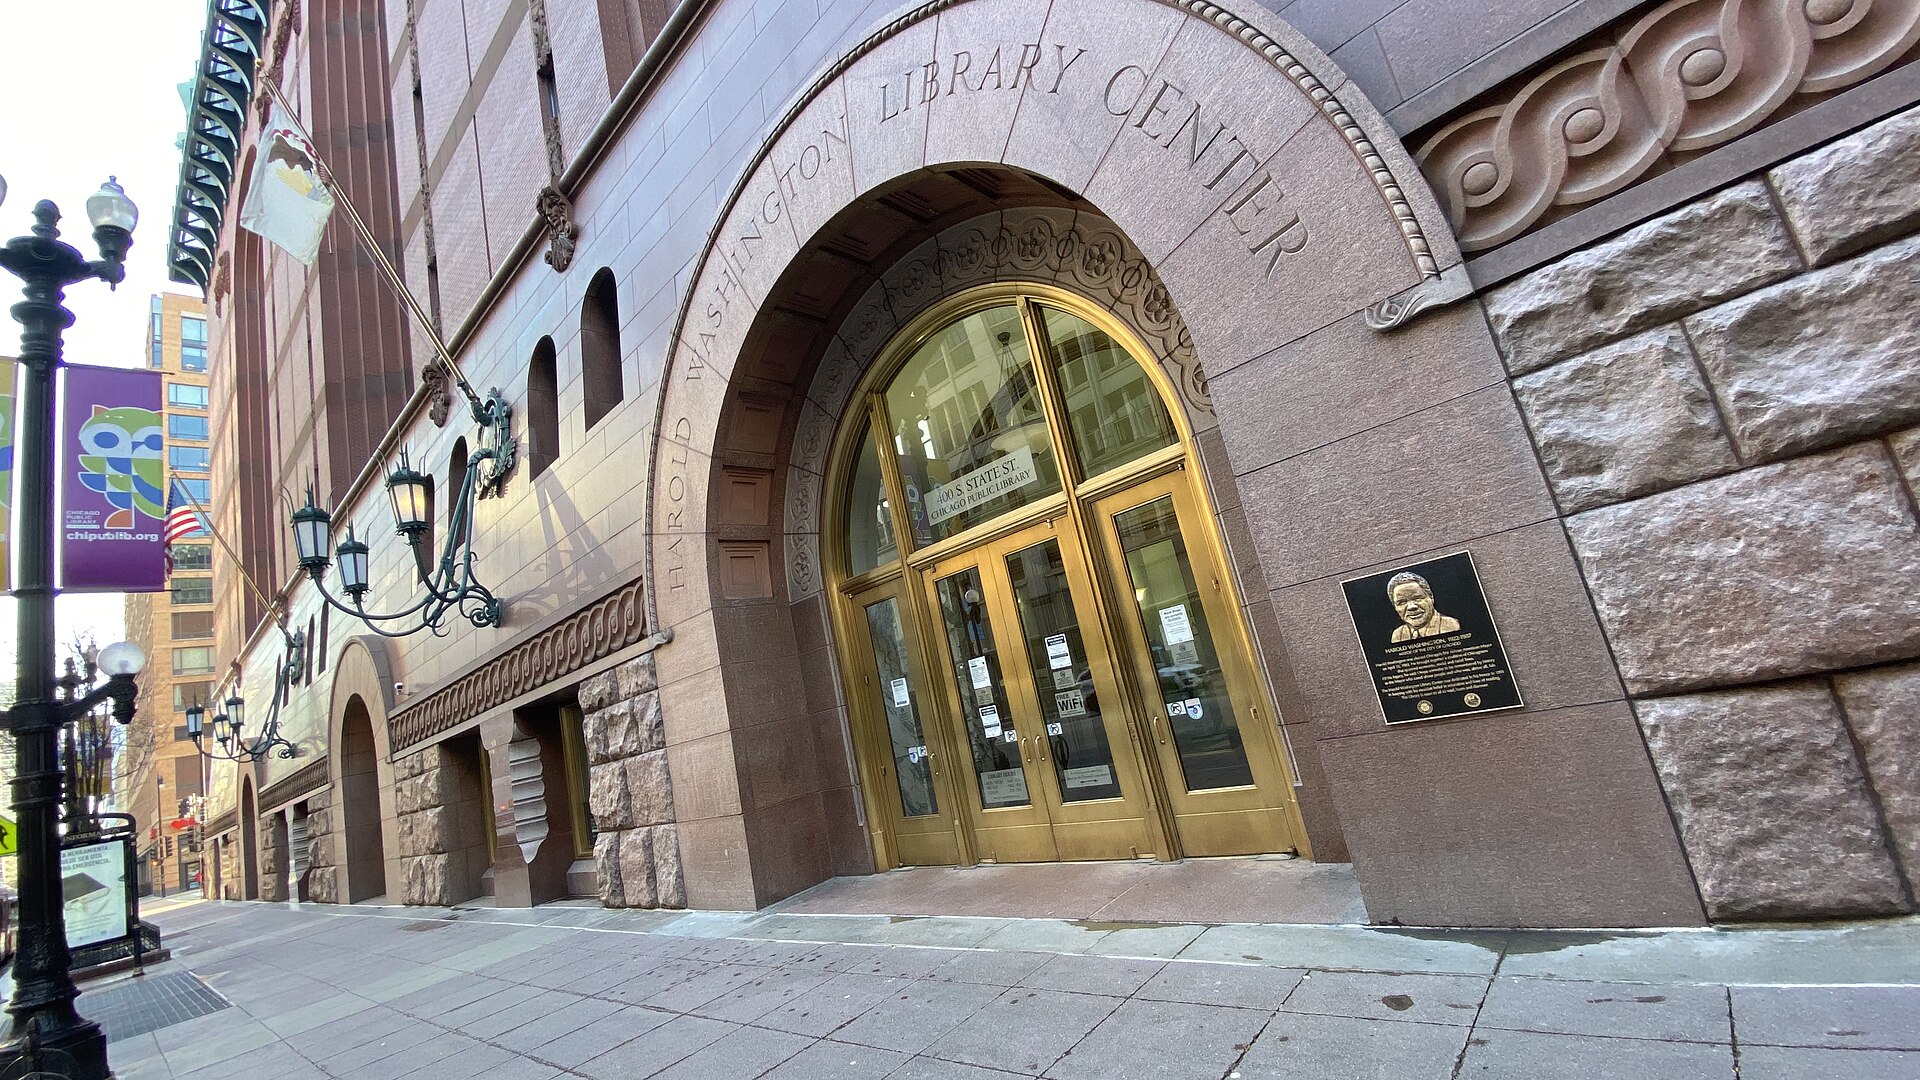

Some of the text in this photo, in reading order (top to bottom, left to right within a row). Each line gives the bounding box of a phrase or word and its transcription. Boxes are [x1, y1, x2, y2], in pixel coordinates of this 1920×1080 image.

[667, 43, 1309, 593] HAROLD WASHINGTON LIBRARY CENTER
[936, 458, 1020, 504] 400 S. STATE ST.
[930, 468, 1031, 520] CHICAGO PUBLIC LIBRARY
[66, 531, 159, 542] chipublib.org
[1384, 645, 1408, 654] HAROLD
[1056, 692, 1069, 700] FREE
[1058, 697, 1083, 712] WiFi
